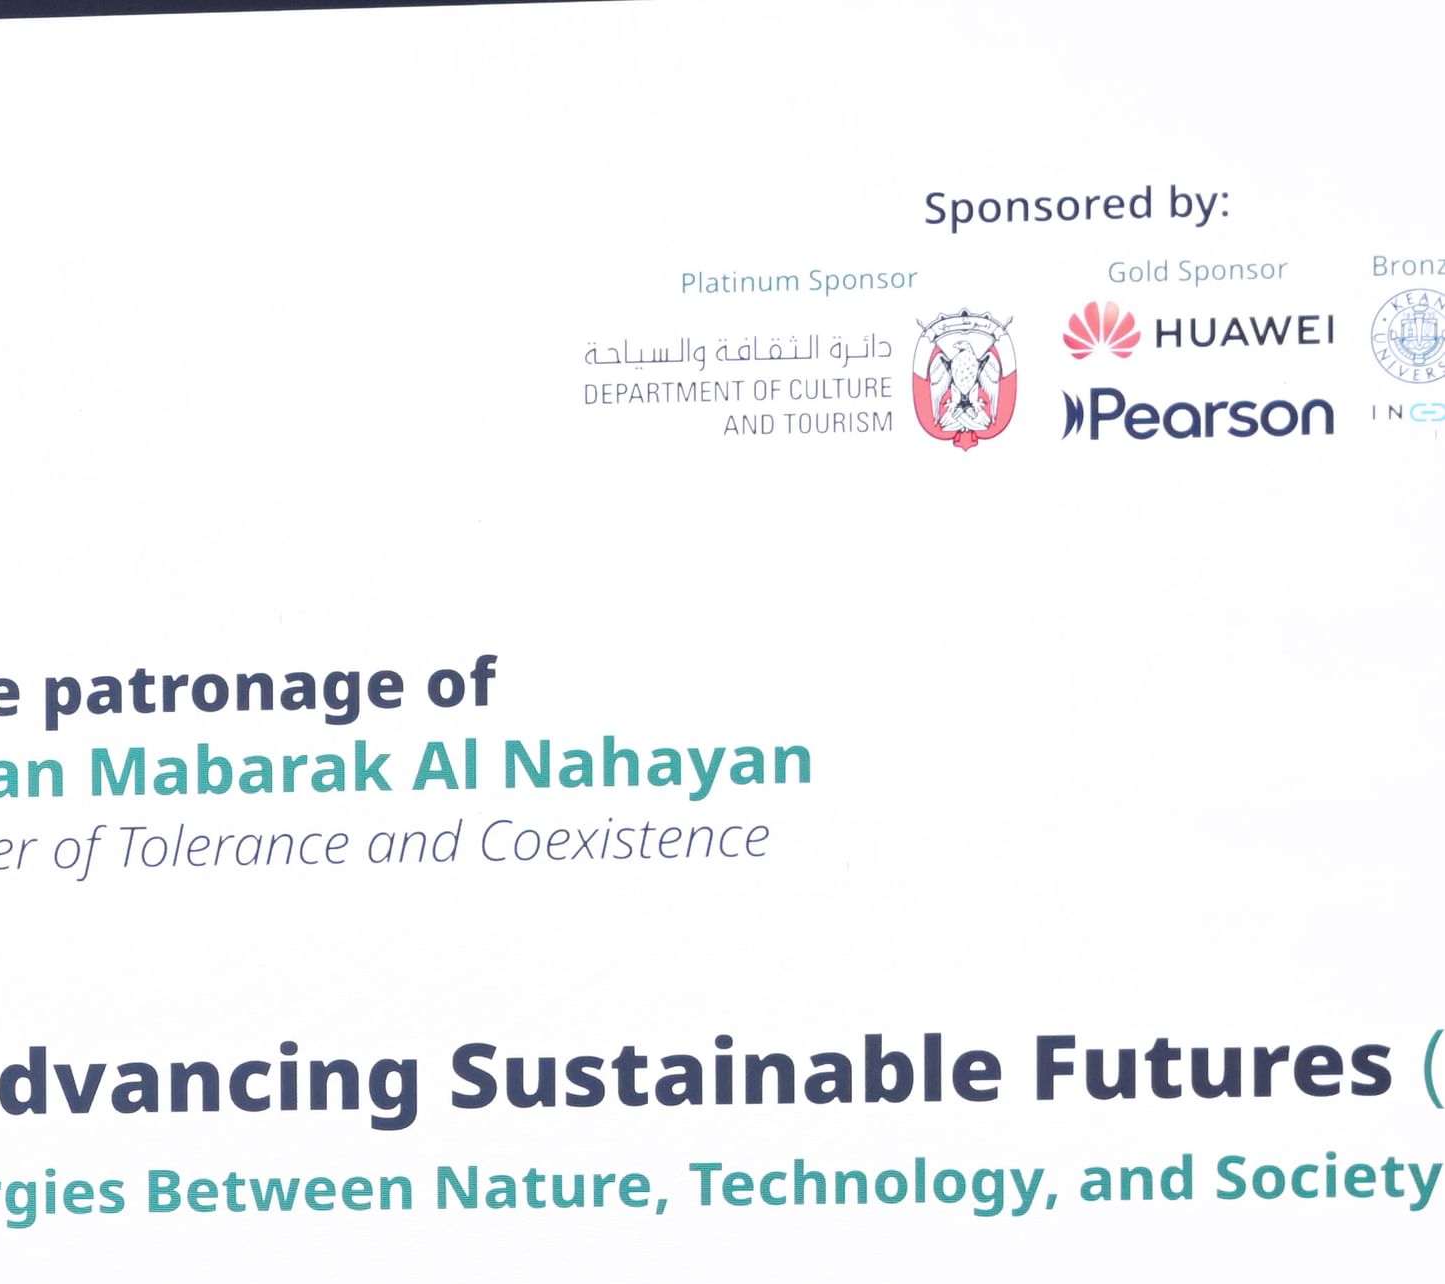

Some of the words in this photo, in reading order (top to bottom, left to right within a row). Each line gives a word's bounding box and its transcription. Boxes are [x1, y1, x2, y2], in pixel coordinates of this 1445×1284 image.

[924, 184, 1152, 235] Sponsored
[1169, 183, 1229, 229] by:
[681, 271, 800, 295] Platinum
[808, 268, 919, 298] Sponsor
[1108, 259, 1168, 284] Gold
[1178, 259, 1289, 289] Sponsor
[715, 333, 819, 362] الثقافة
[1155, 314, 1334, 349] HUAWEI
[584, 336, 706, 372] والسياحة
[829, 332, 892, 369] دائرة
[584, 379, 746, 406] DEPARTMENT
[753, 379, 782, 402] OF
[789, 376, 893, 401] CULTURE
[723, 413, 775, 437] AND
[782, 410, 893, 435] TOURISM
[1089, 386, 1335, 441] Pearson
[44, 667, 405, 732] patronage
[426, 653, 499, 709] of
[90, 739, 394, 797] Mabarak
[411, 736, 478, 791] Al
[504, 734, 812, 802] Nahayan
[53, 823, 108, 883] of
[118, 822, 350, 869] Tolerance
[367, 817, 464, 865] and
[481, 816, 770, 863] Coexistence
[451, 1031, 1002, 1110] Sustainable
[1035, 1034, 1393, 1101] Futures
[147, 1169, 413, 1214] Between
[436, 1164, 669, 1216] Nature,
[688, 1155, 1058, 1218] Technology,
[1079, 1152, 1194, 1202] and
[1216, 1150, 1444, 1213] Society
